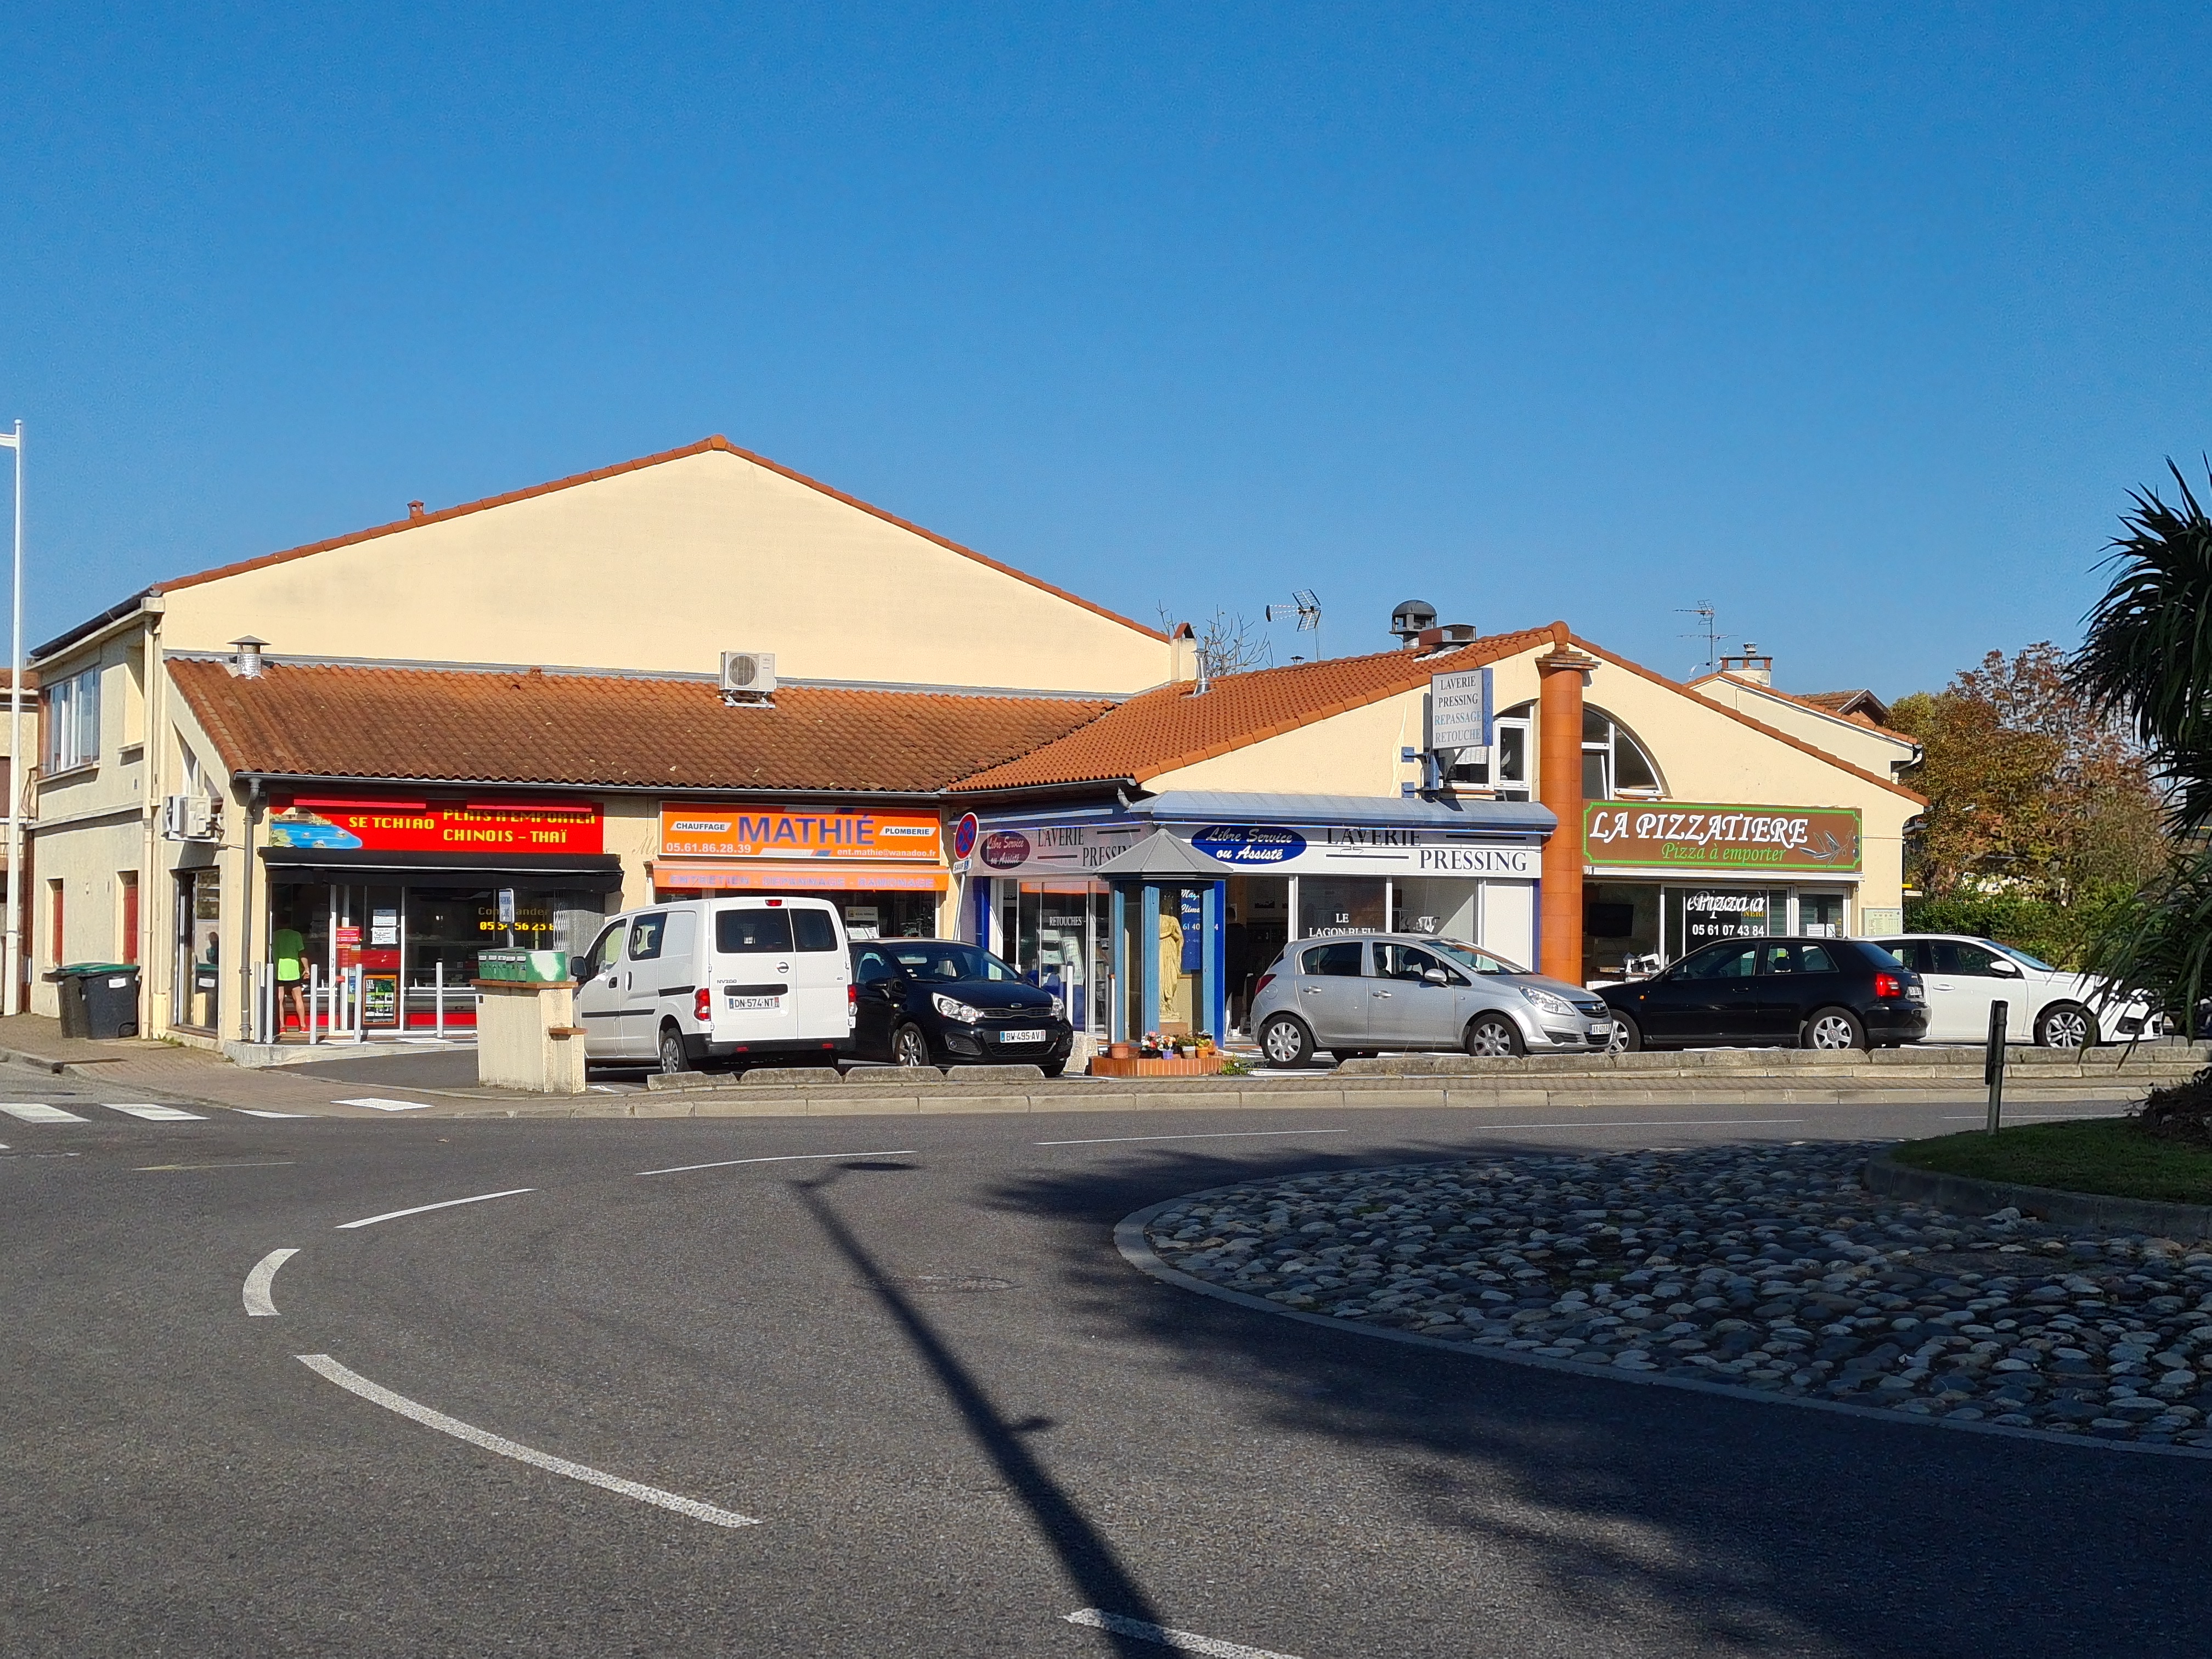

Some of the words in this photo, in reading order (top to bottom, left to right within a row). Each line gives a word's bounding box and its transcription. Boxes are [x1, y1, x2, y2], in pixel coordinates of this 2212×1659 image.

[1440, 675, 1476, 690] LAVERIE
[1438, 693, 1479, 708] PRESSING
[1434, 710, 1481, 726] REPASSAGE
[1435, 728, 1481, 743] RETOUCHE
[349, 817, 368, 828] SE
[372, 817, 435, 830] TCHIAO
[443, 809, 491, 822] PLATS
[496, 810, 506, 822] A
[511, 811, 595, 824] EMPORTER
[676, 822, 725, 831] CHAUFFAGE
[738, 814, 874, 845] MATHIÉ
[1589, 811, 1629, 843] LA
[1636, 813, 1809, 849] PIZZATIERE
[443, 828, 514, 842] CHINOIS
[529, 829, 567, 843] THAÏ
[1037, 827, 1085, 847] LAVERIE
[1206, 827, 1242, 843] Libre
[1247, 828, 1293, 843] Service
[1327, 828, 1421, 846] LAVERIE
[666, 842, 752, 854] 05.61.86.28.39
[986, 836, 1002, 850] Libre
[1003, 836, 1024, 849] Service
[837, 849, 936, 857] ent.mathie@wanadoo.fr
[1216, 850, 1233, 859] ou
[1662, 842, 1706, 859] Pizza
[1710, 843, 1718, 860] à
[1723, 847, 1787, 864] emporter
[954, 862, 964, 871] SAUF
[1419, 850, 1527, 871] PRESSING
[669, 874, 750, 885] ENTRETIEN
[857, 877, 934, 888] RAMONAGE
[478, 907, 550, 916] Comander
[1335, 913, 1350, 923] LE
[515, 922, 529, 930] 56
[1049, 916, 1082, 926] RETOUCHES
[1309, 927, 1346, 937] LAGON
[1692, 924, 1705, 935] 05
[1707, 924, 1719, 936] 61
[1722, 924, 1735, 936] 07
[1737, 924, 1750, 936] 43
[1752, 925, 1765, 936] 84
[735, 998, 774, 1008] DN-574-NT
[1006, 1031, 1040, 1041] BW-495-AV
